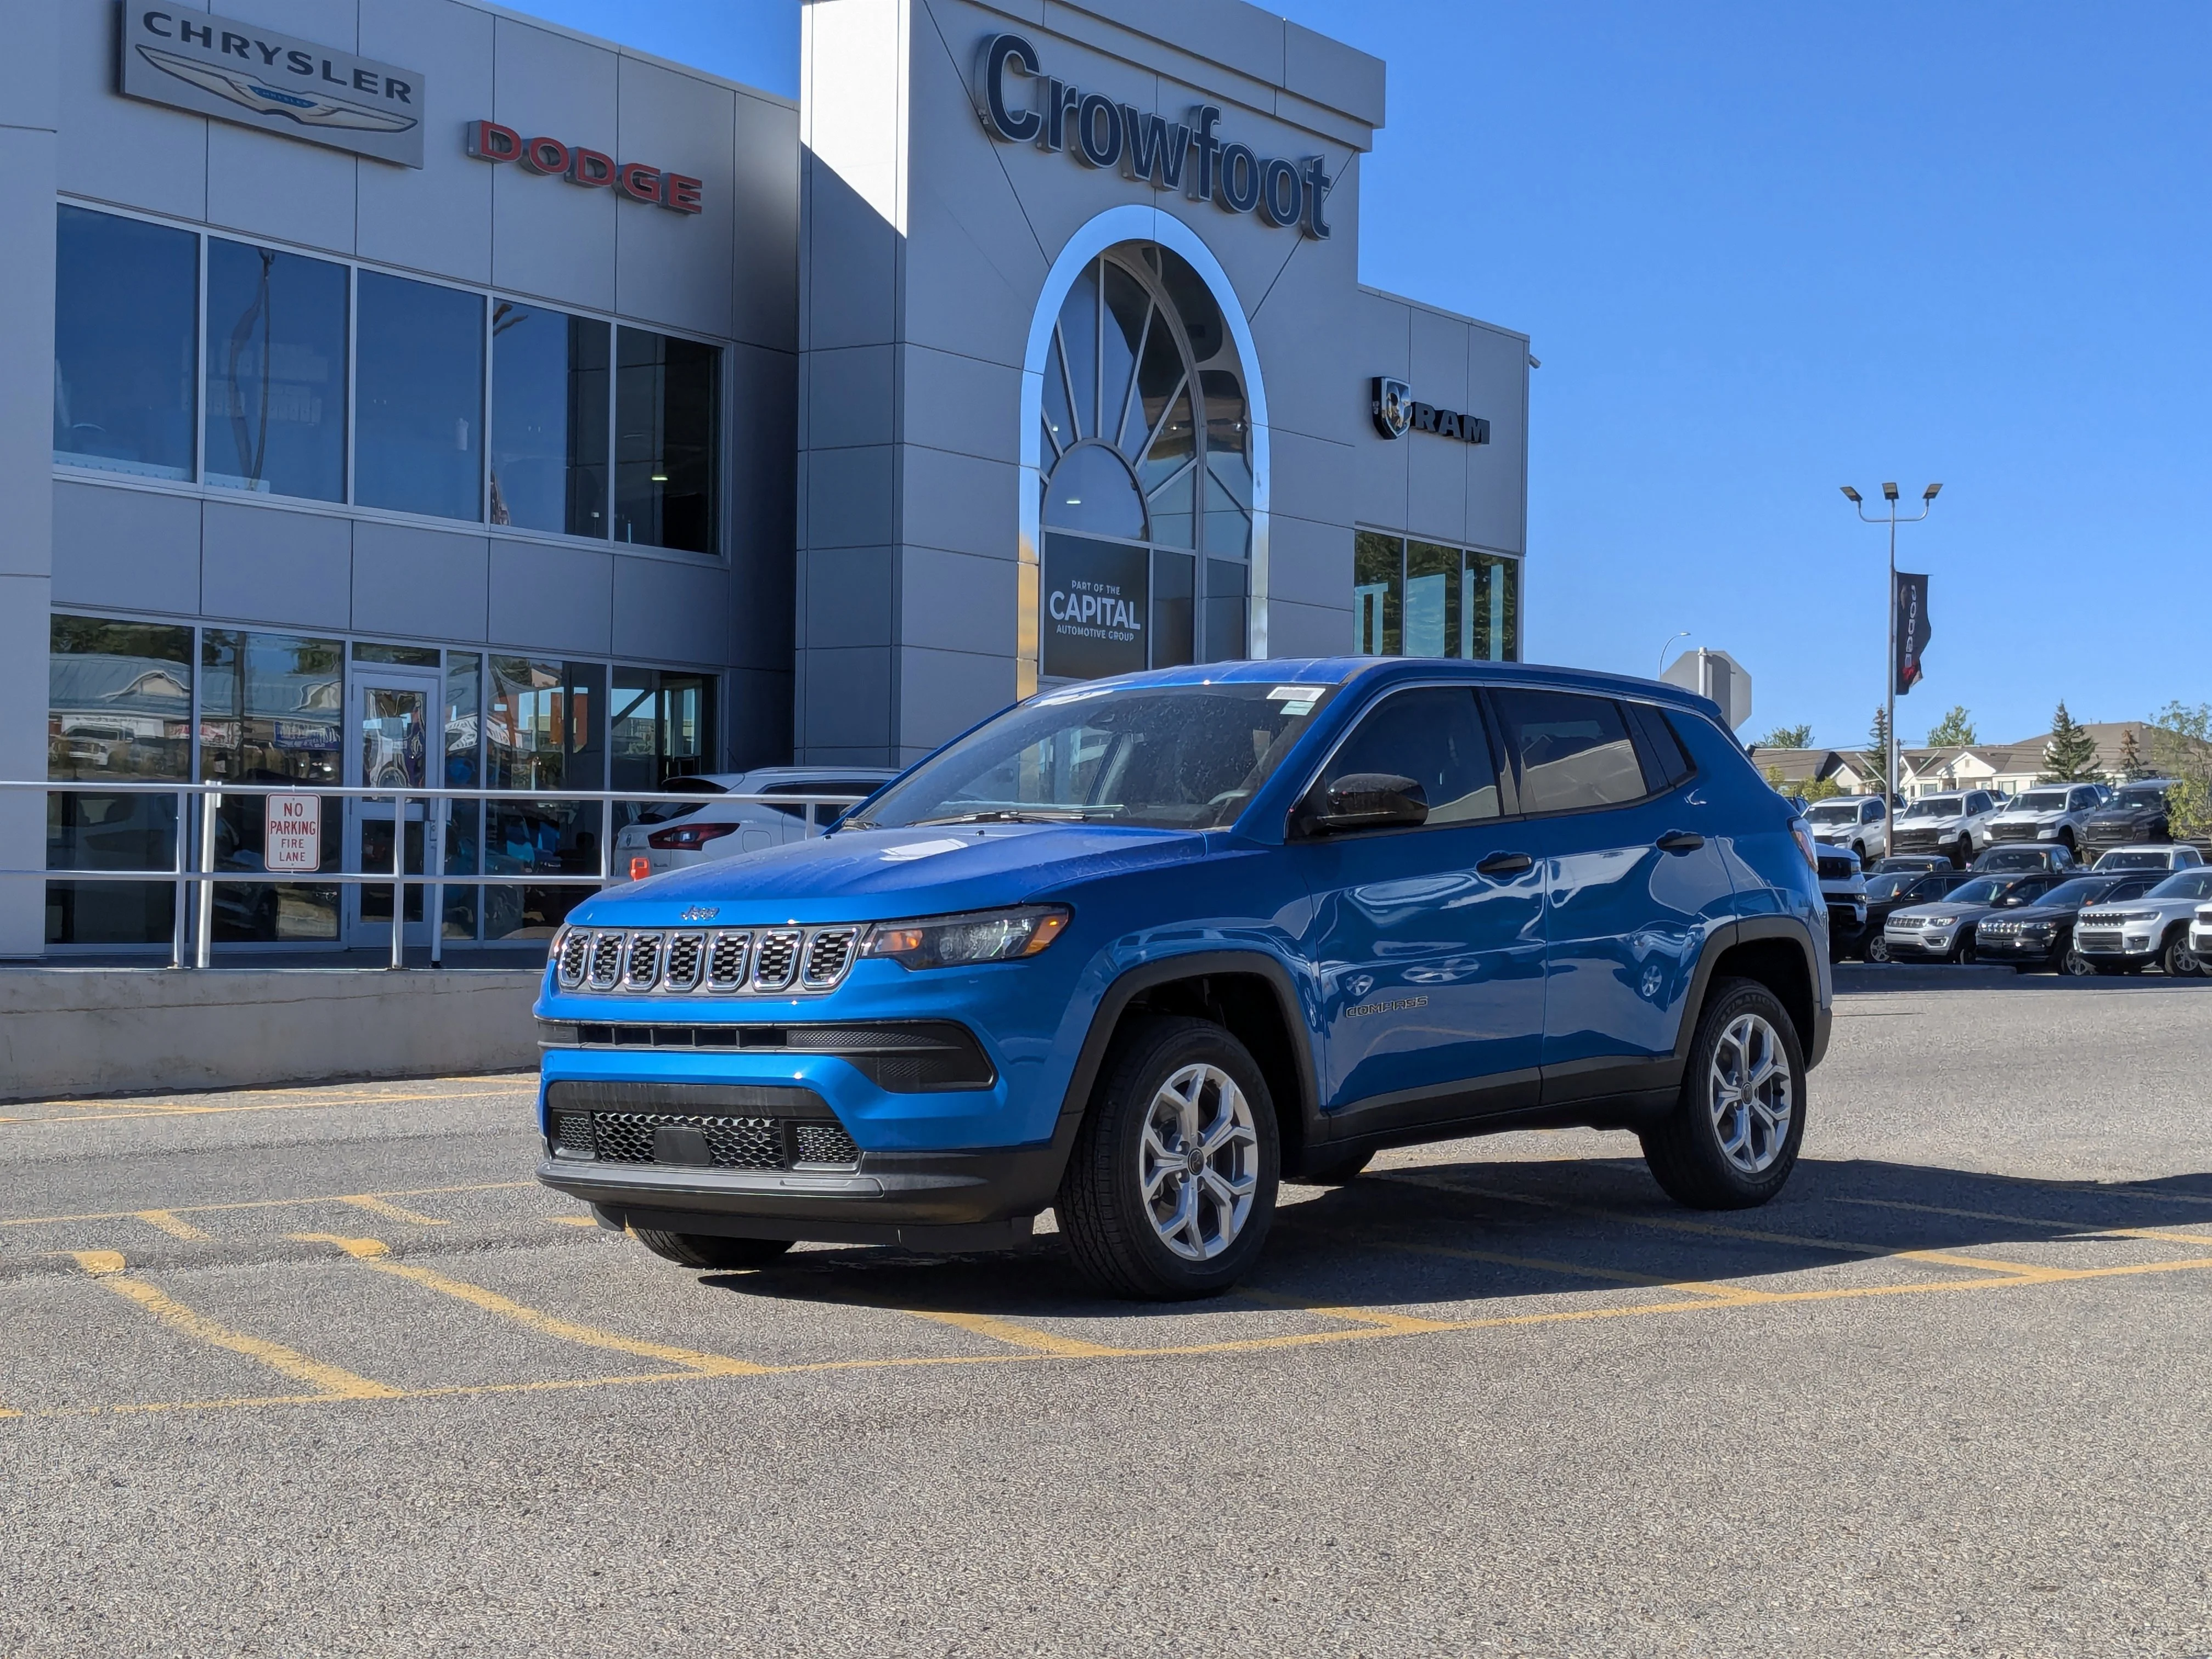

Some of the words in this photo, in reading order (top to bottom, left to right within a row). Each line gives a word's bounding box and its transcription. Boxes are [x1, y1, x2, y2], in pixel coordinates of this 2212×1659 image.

[143, 11, 411, 104] CHRYSLER
[981, 32, 1331, 240] Crowfoot
[474, 119, 703, 215] DODGE
[1411, 401, 1491, 445] RAM
[1071, 580, 1091, 591] PART
[1093, 583, 1104, 593] OF
[1106, 585, 1121, 595] THE
[1049, 590, 1141, 630] CAPITAL
[1056, 624, 1107, 639] AUTOMOTIVE
[1108, 630, 1135, 642] GROUP
[283, 803, 303, 817] NO
[270, 820, 316, 836] PARKING
[281, 838, 304, 849] FIRE
[279, 851, 306, 862] LANE
[1346, 995, 1429, 1018] COMPASS
